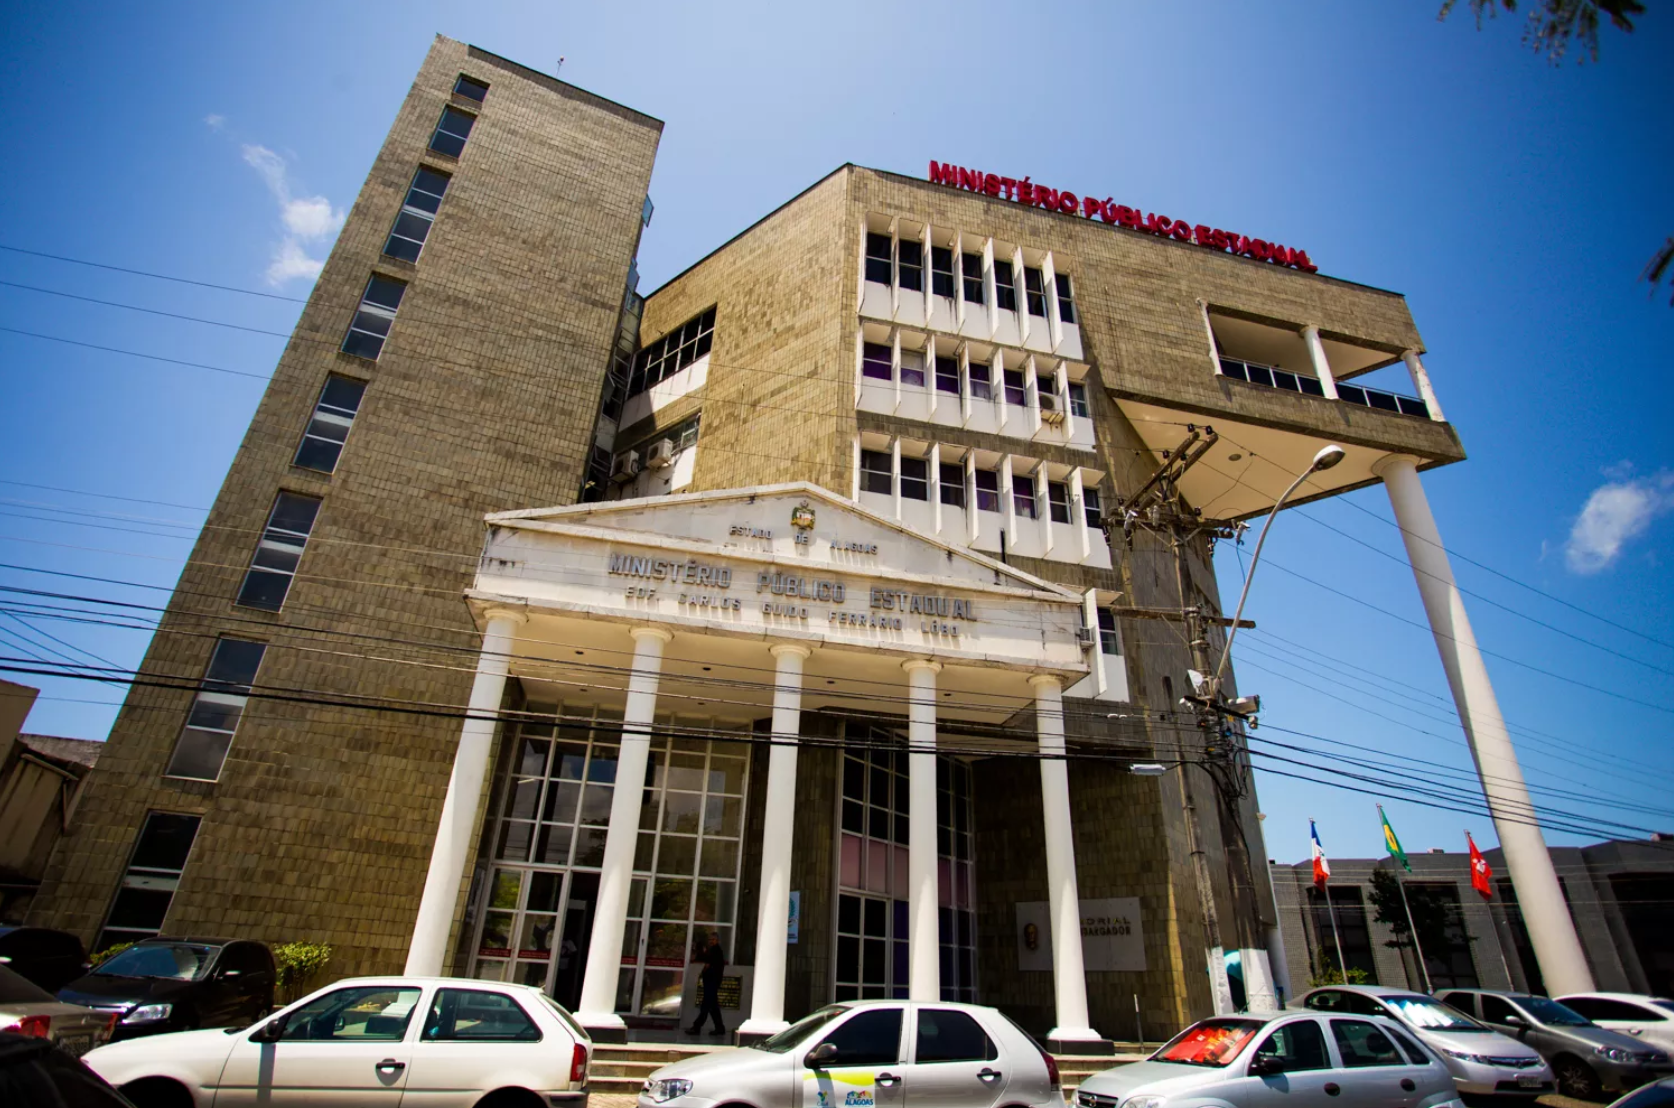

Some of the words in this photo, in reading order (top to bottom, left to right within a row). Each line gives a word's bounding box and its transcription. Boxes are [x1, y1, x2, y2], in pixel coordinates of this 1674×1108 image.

[928, 160, 1079, 214] MINISTÉRIO
[1083, 197, 1192, 242] PÚBLICO
[1194, 224, 1318, 273] ESTADUAL
[729, 525, 773, 540] ESTADO
[795, 533, 808, 545] DE
[830, 538, 878, 555] ALAGOAS
[608, 553, 732, 588] MINISTÉRIO
[756, 571, 846, 603] PÚBLICO
[870, 586, 977, 622] ESTADUAL
[678, 593, 741, 611] CARLOS
[762, 601, 808, 619] GUIDO
[1081, 916, 1130, 925] ORIAL
